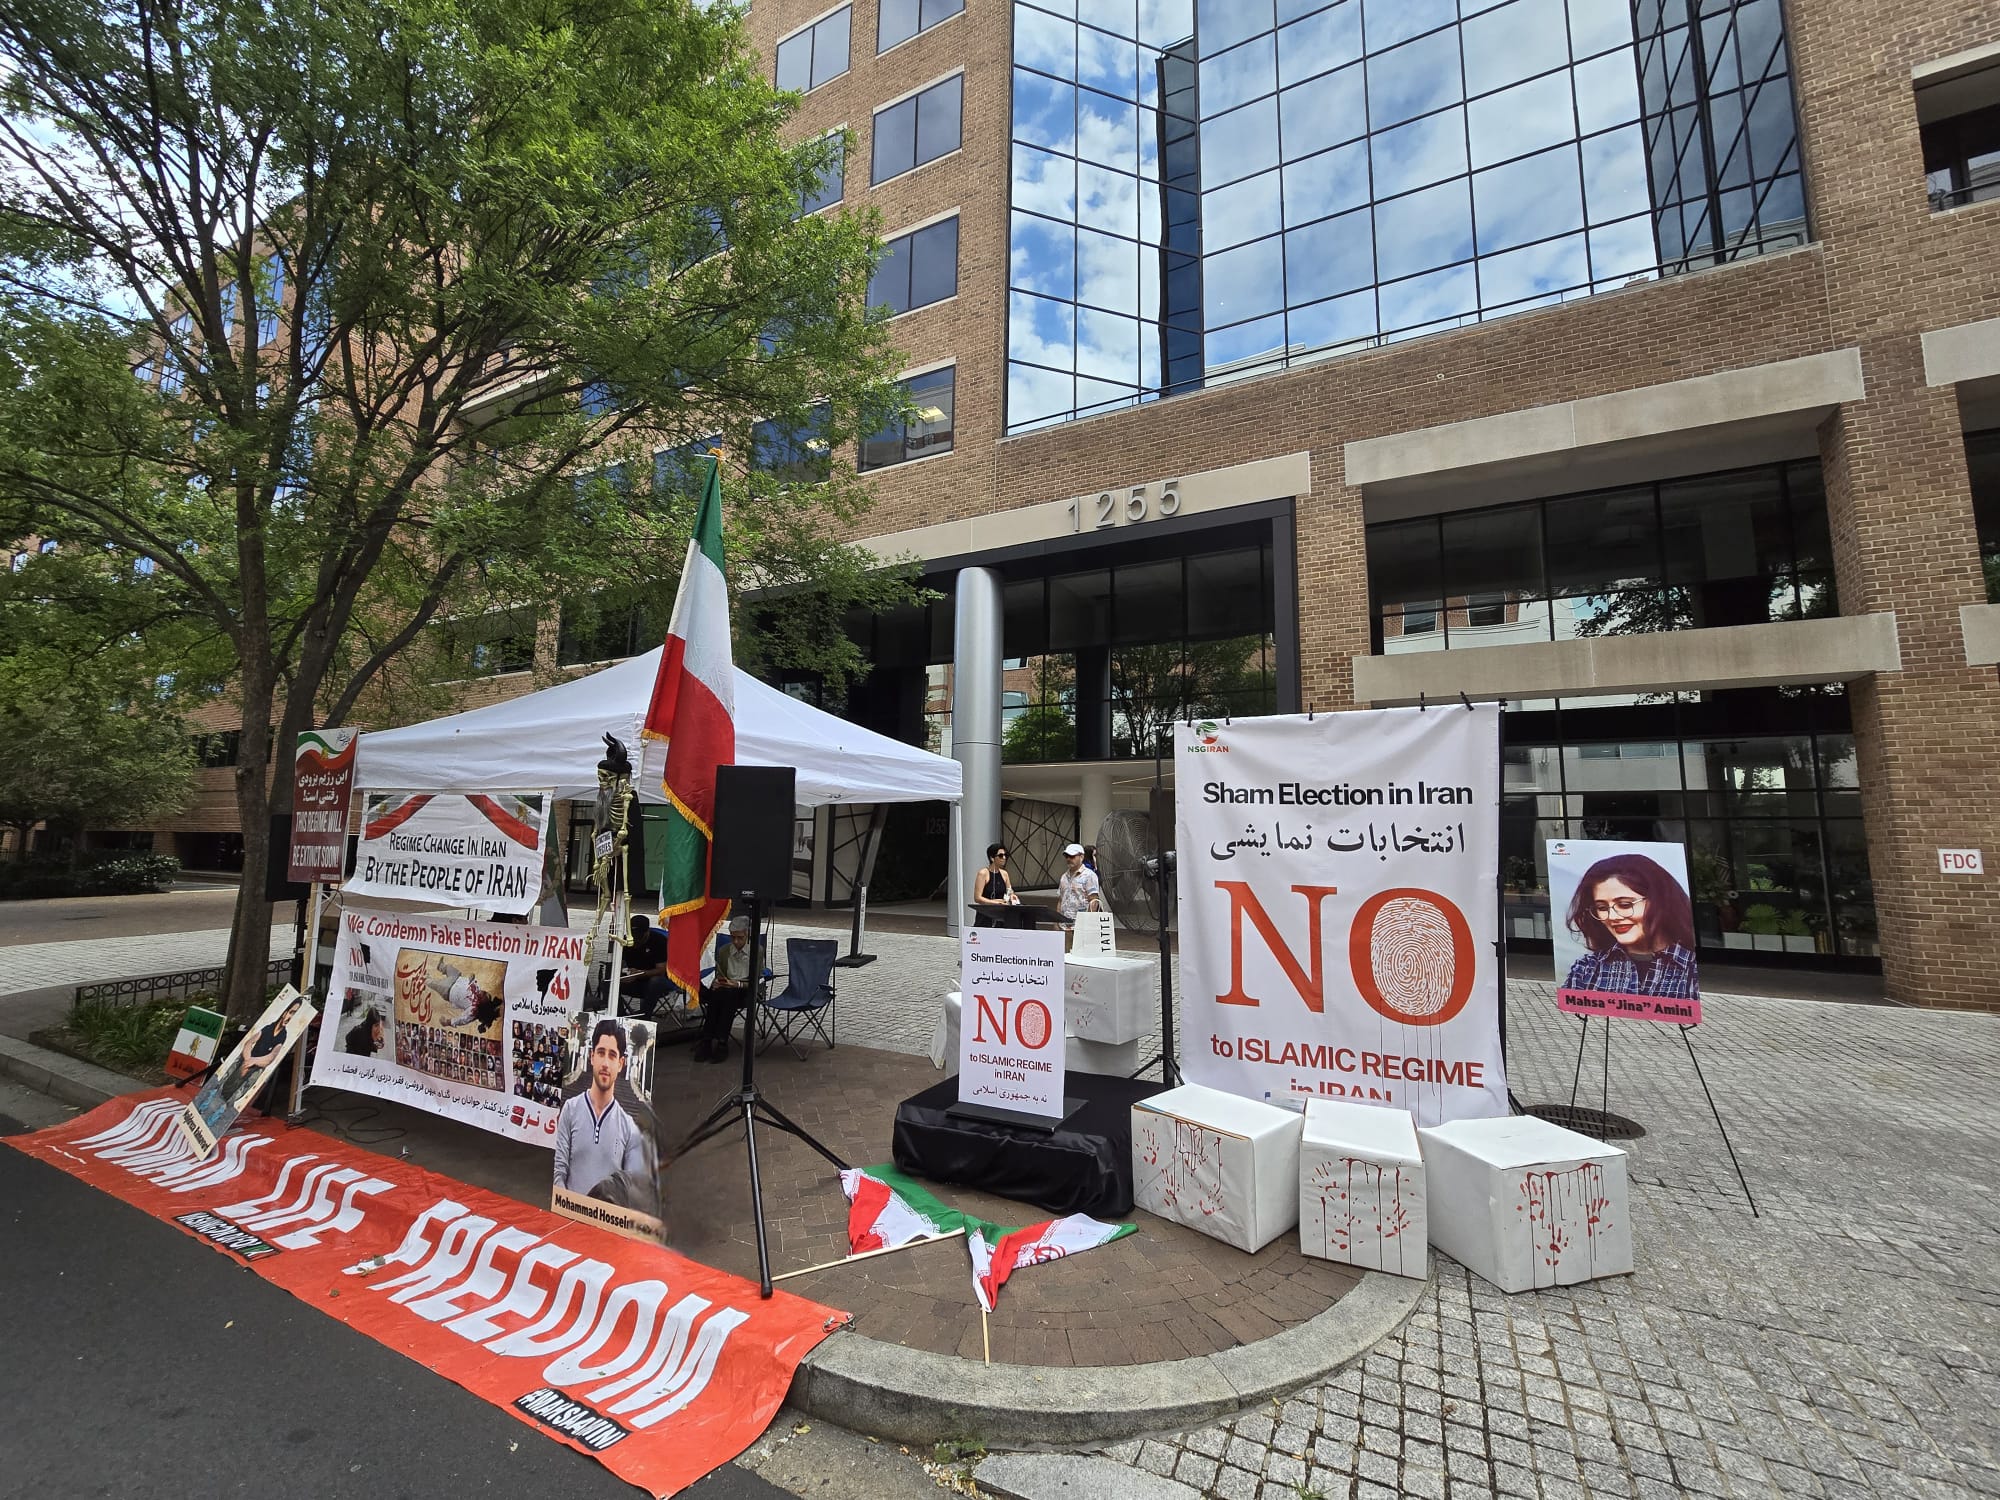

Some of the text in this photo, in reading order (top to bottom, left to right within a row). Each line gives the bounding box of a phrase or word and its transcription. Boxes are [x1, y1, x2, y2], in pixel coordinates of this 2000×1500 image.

[1068, 478, 1181, 532] 1255
[1187, 745, 1229, 753] NSGIRAN
[1203, 781, 1473, 806] Sham Election in Iran
[389, 832, 507, 858] REGIME CHANGE IN IRAN
[1210, 820, 1466, 862] انتخابات نمایشی
[1943, 853, 1977, 869] FDC
[365, 856, 528, 900] BY THE PEOPLE OF IRAN
[348, 914, 584, 961] We Condemn Fake Election in IRAN
[1100, 915, 1111, 952] TATTE
[349, 947, 364, 968] NO
[971, 952, 1054, 968] Sham Election in Iran
[1214, 880, 1476, 1027] NO
[550, 964, 570, 1000] نه
[972, 970, 1048, 988] انتخابات نمایشی
[1565, 994, 1606, 1008] Mahsa
[1654, 1003, 1693, 1018] Amini
[972, 994, 1053, 1050] NO
[970, 1052, 1052, 1072] to ISLAMIC REGIME
[1210, 1034, 1485, 1088] to ISLAMIC REGIME
[994, 1068, 1026, 1082] in IRAN
[972, 1085, 1048, 1104] نه به جمهوری اسلامی
[555, 1193, 598, 1220] Mohammad
[213, 1154, 398, 1250] LIFE
[341, 1198, 751, 1429] FREEDOM
[517, 1388, 627, 1450] #MAHSAAMINI
